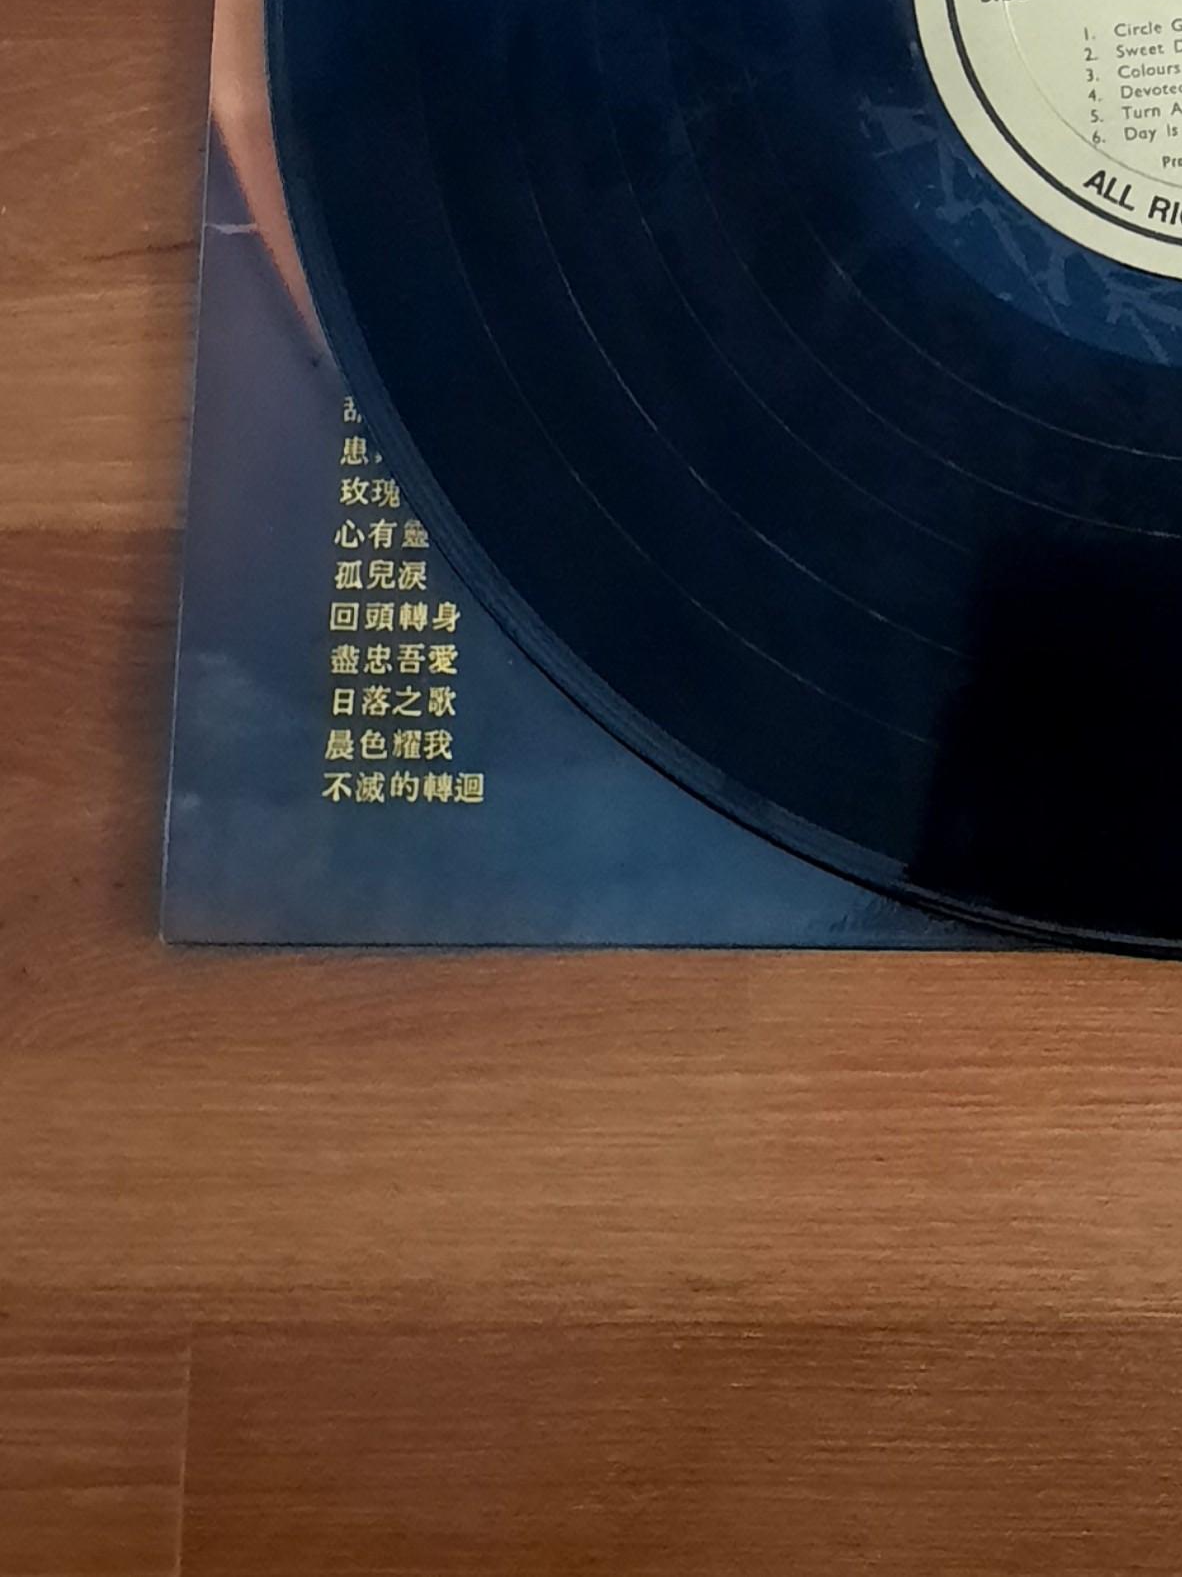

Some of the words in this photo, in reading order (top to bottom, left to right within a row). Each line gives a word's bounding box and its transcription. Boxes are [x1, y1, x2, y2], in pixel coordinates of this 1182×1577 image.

[1114, 22, 1163, 37] Circle
[1116, 44, 1165, 59] Sweet
[1086, 68, 1100, 82] 3.
[1117, 64, 1181, 79] Colours
[1090, 109, 1104, 123] 5.
[1122, 106, 1161, 120] Turn
[1092, 130, 1106, 144] 6.
[1124, 127, 1157, 143] Day
[1082, 169, 1135, 211] ALL
[340, 436, 384, 466] 患
[329, 601, 461, 632] 回頭轉身
[330, 643, 458, 675] 盡忠吾愛
[332, 684, 457, 717] 日落之歌
[324, 728, 453, 760] 晨色耀我
